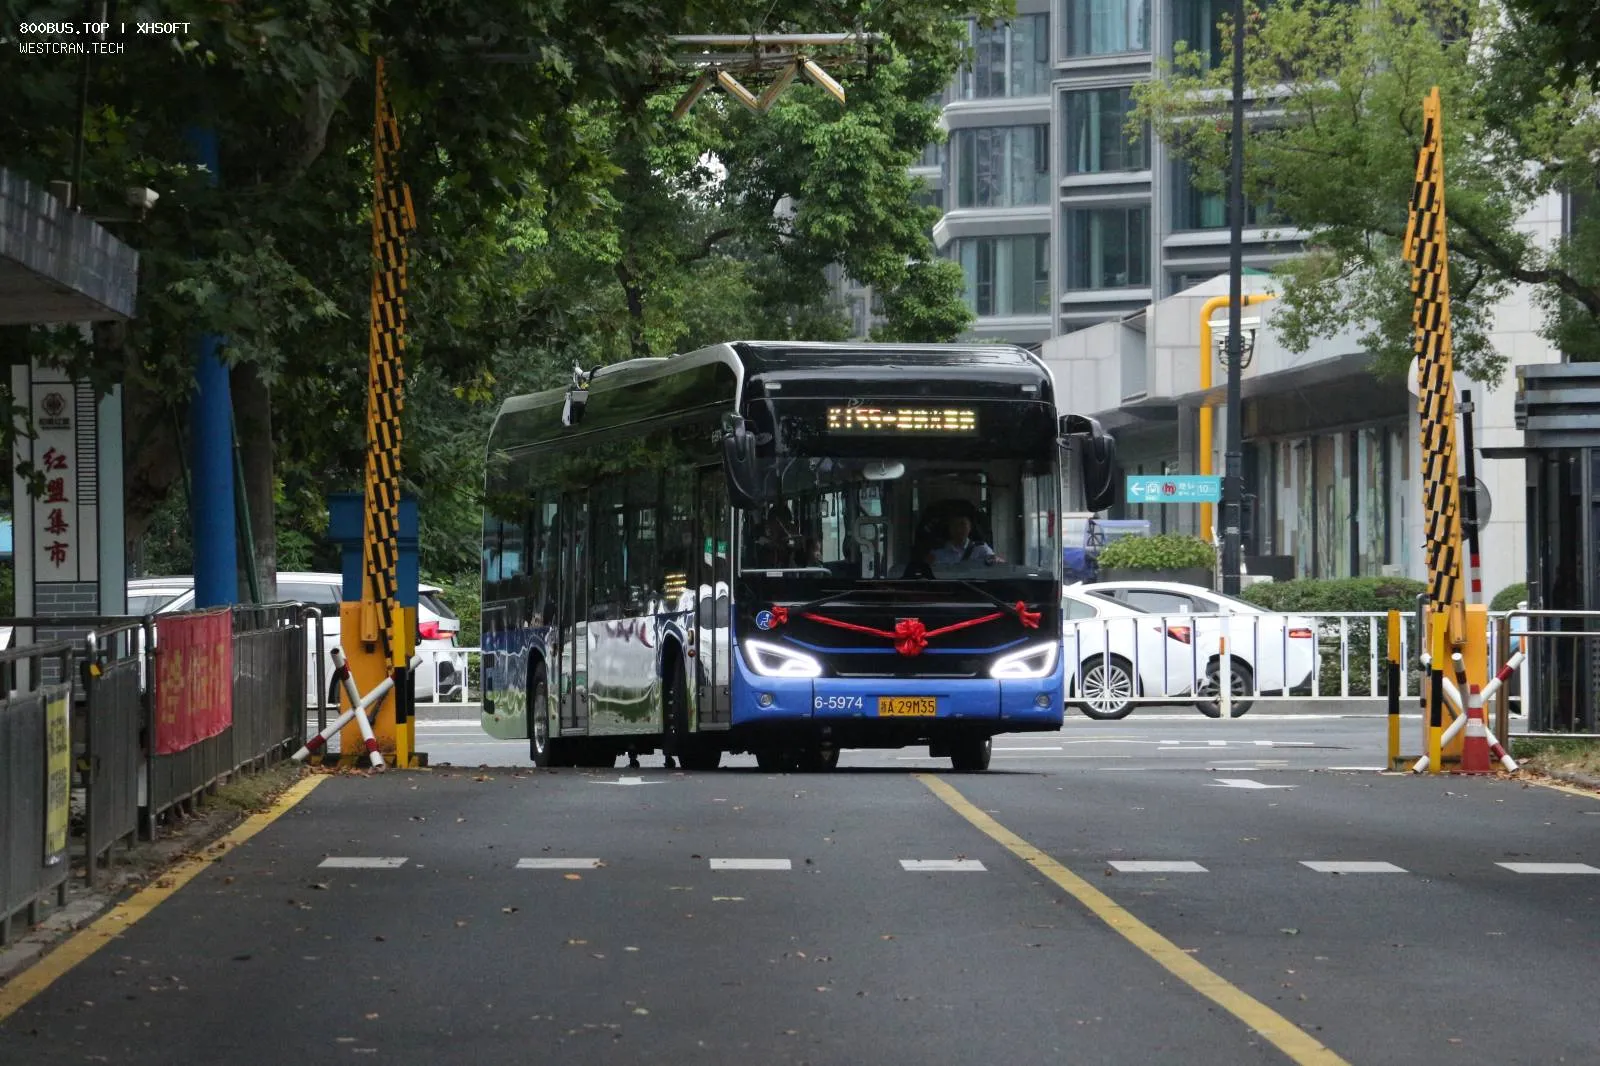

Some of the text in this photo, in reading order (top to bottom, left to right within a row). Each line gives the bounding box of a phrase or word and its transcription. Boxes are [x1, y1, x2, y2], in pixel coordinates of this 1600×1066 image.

[43, 446, 69, 569] 红盟集市
[814, 696, 863, 709] 6-5974
